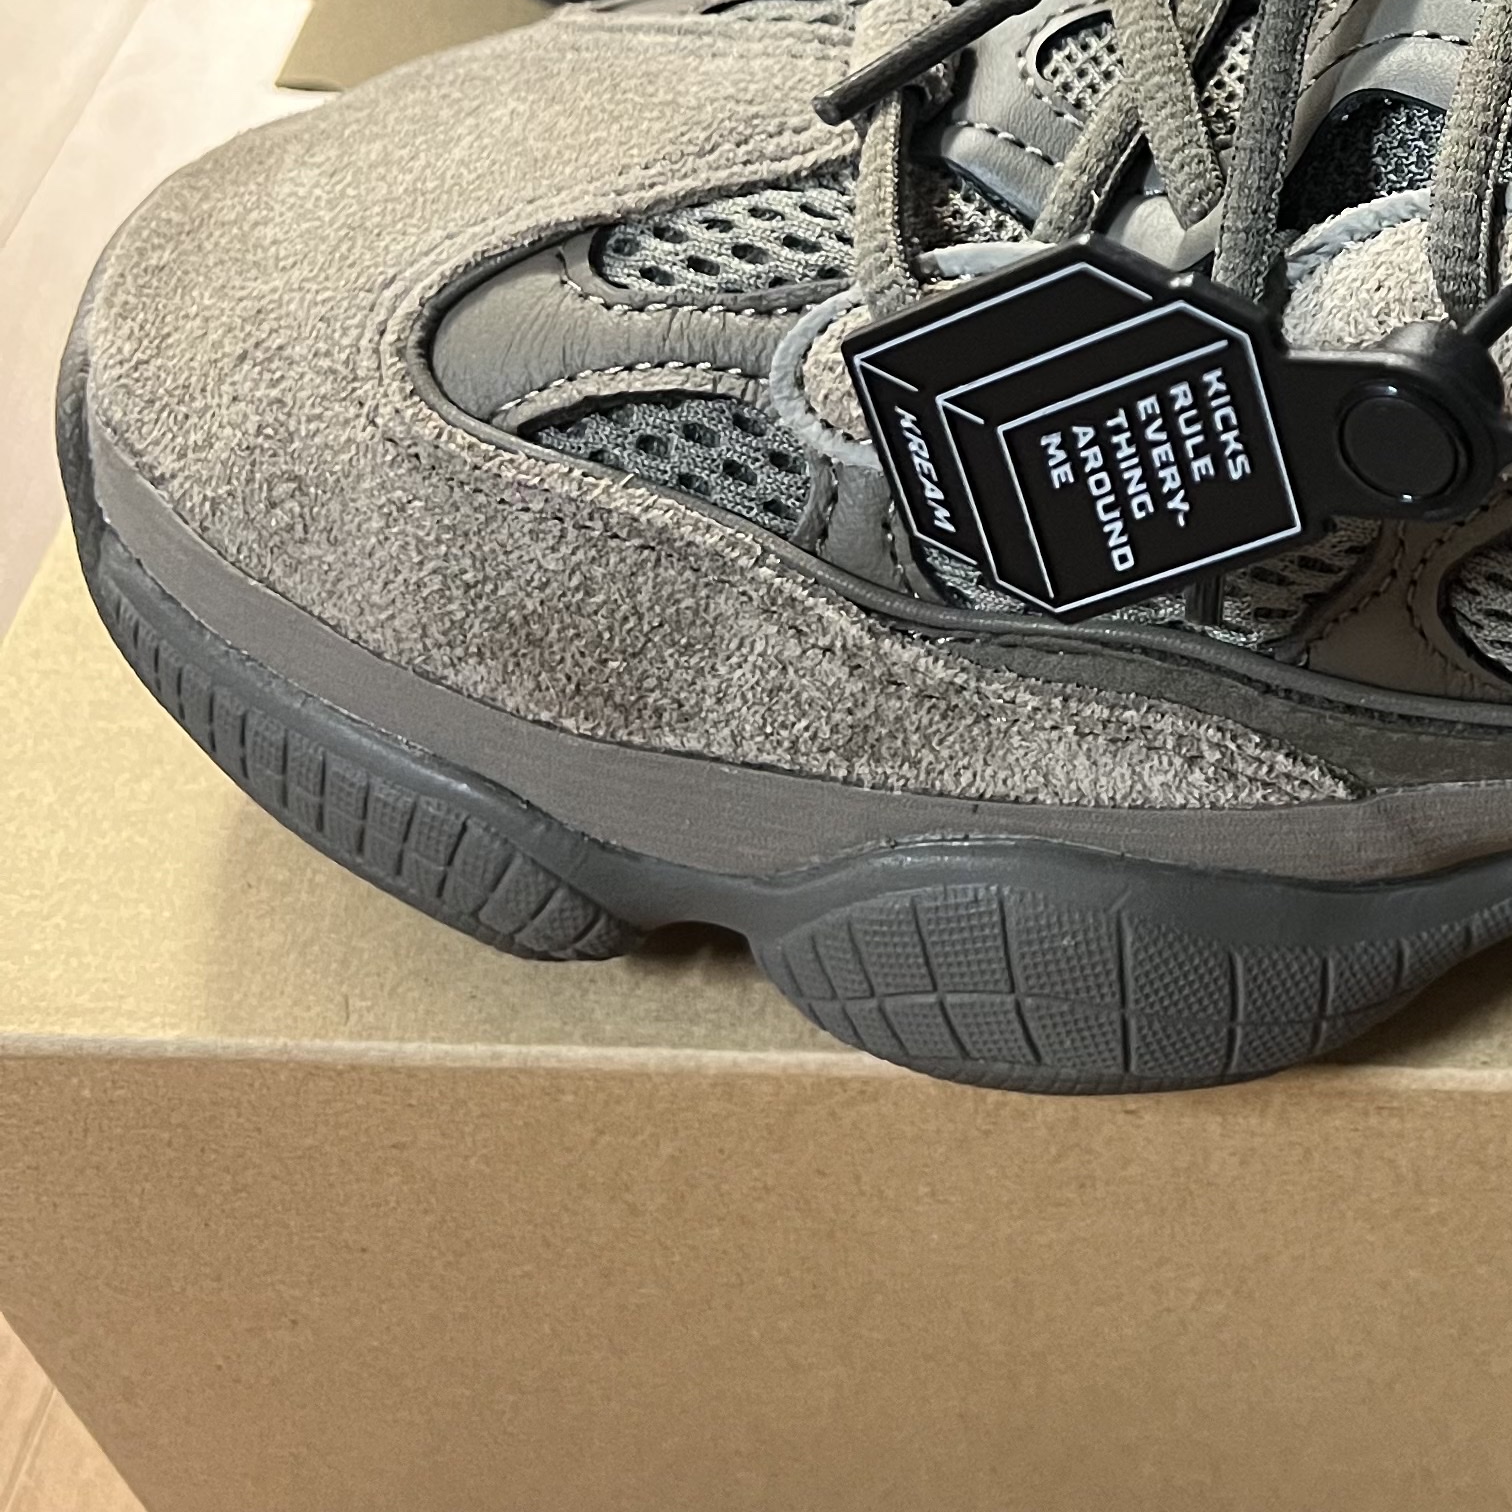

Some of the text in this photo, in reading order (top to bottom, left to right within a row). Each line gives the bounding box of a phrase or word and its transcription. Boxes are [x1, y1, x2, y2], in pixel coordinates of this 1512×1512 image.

[894, 405, 957, 534] KREAM
[1039, 432, 1074, 490] ME
[1105, 409, 1153, 522] THING
[1136, 394, 1192, 528] EVERY-
[1169, 380, 1216, 480] RULE
[1201, 367, 1252, 482] KICKS
[1071, 425, 1136, 573] AROUND
